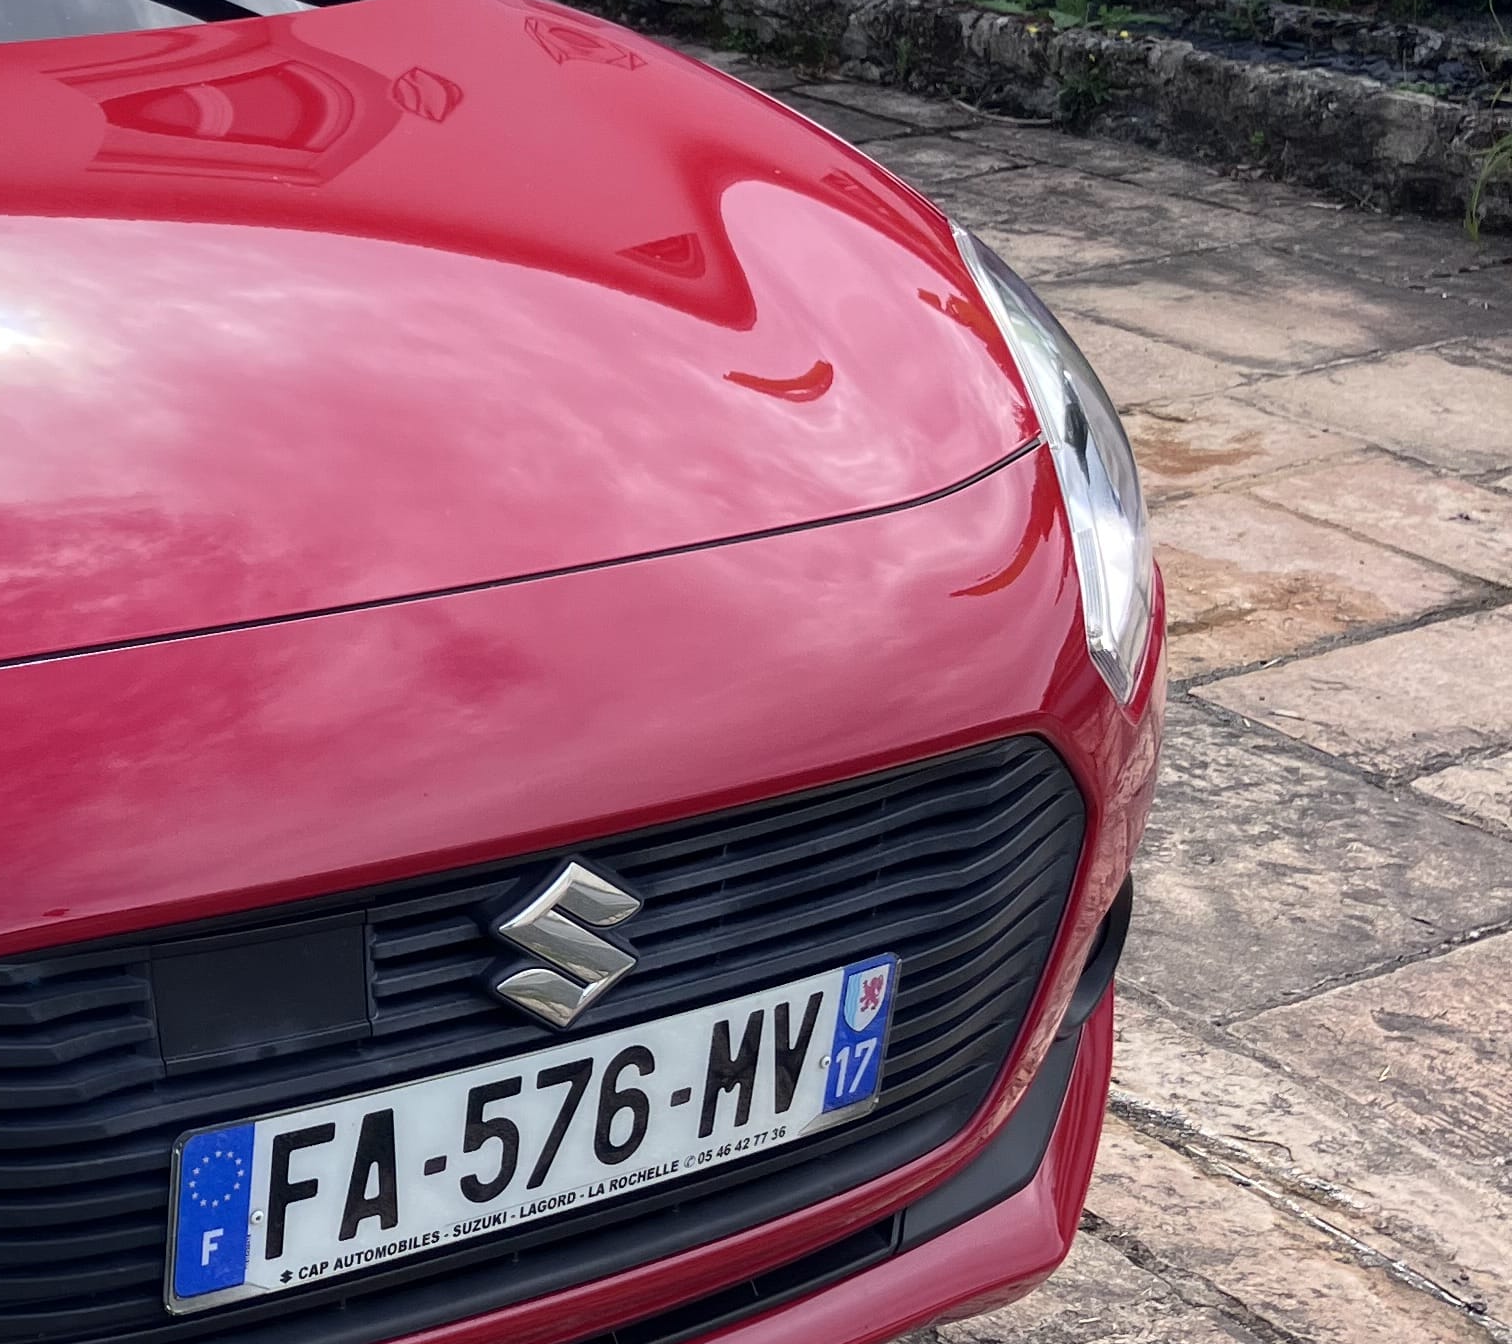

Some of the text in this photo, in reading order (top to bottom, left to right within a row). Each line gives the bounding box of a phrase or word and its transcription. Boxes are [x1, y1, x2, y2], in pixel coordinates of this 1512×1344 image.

[835, 1037, 878, 1098] 17
[264, 991, 824, 1261] FA-576-MV
[201, 1227, 225, 1267] F
[298, 1261, 329, 1280] CAP
[333, 1230, 441, 1271] AUTOMOBILES
[452, 1211, 507, 1238] SUZUKI
[519, 1191, 576, 1219] LAGORD
[588, 1185, 605, 1199] LA
[609, 1160, 680, 1192] ROCHELLE
[697, 1150, 713, 1164] 05
[716, 1144, 731, 1158] 46
[734, 1137, 750, 1151] 42
[754, 1132, 768, 1146] 77
[771, 1126, 787, 1140] 36
